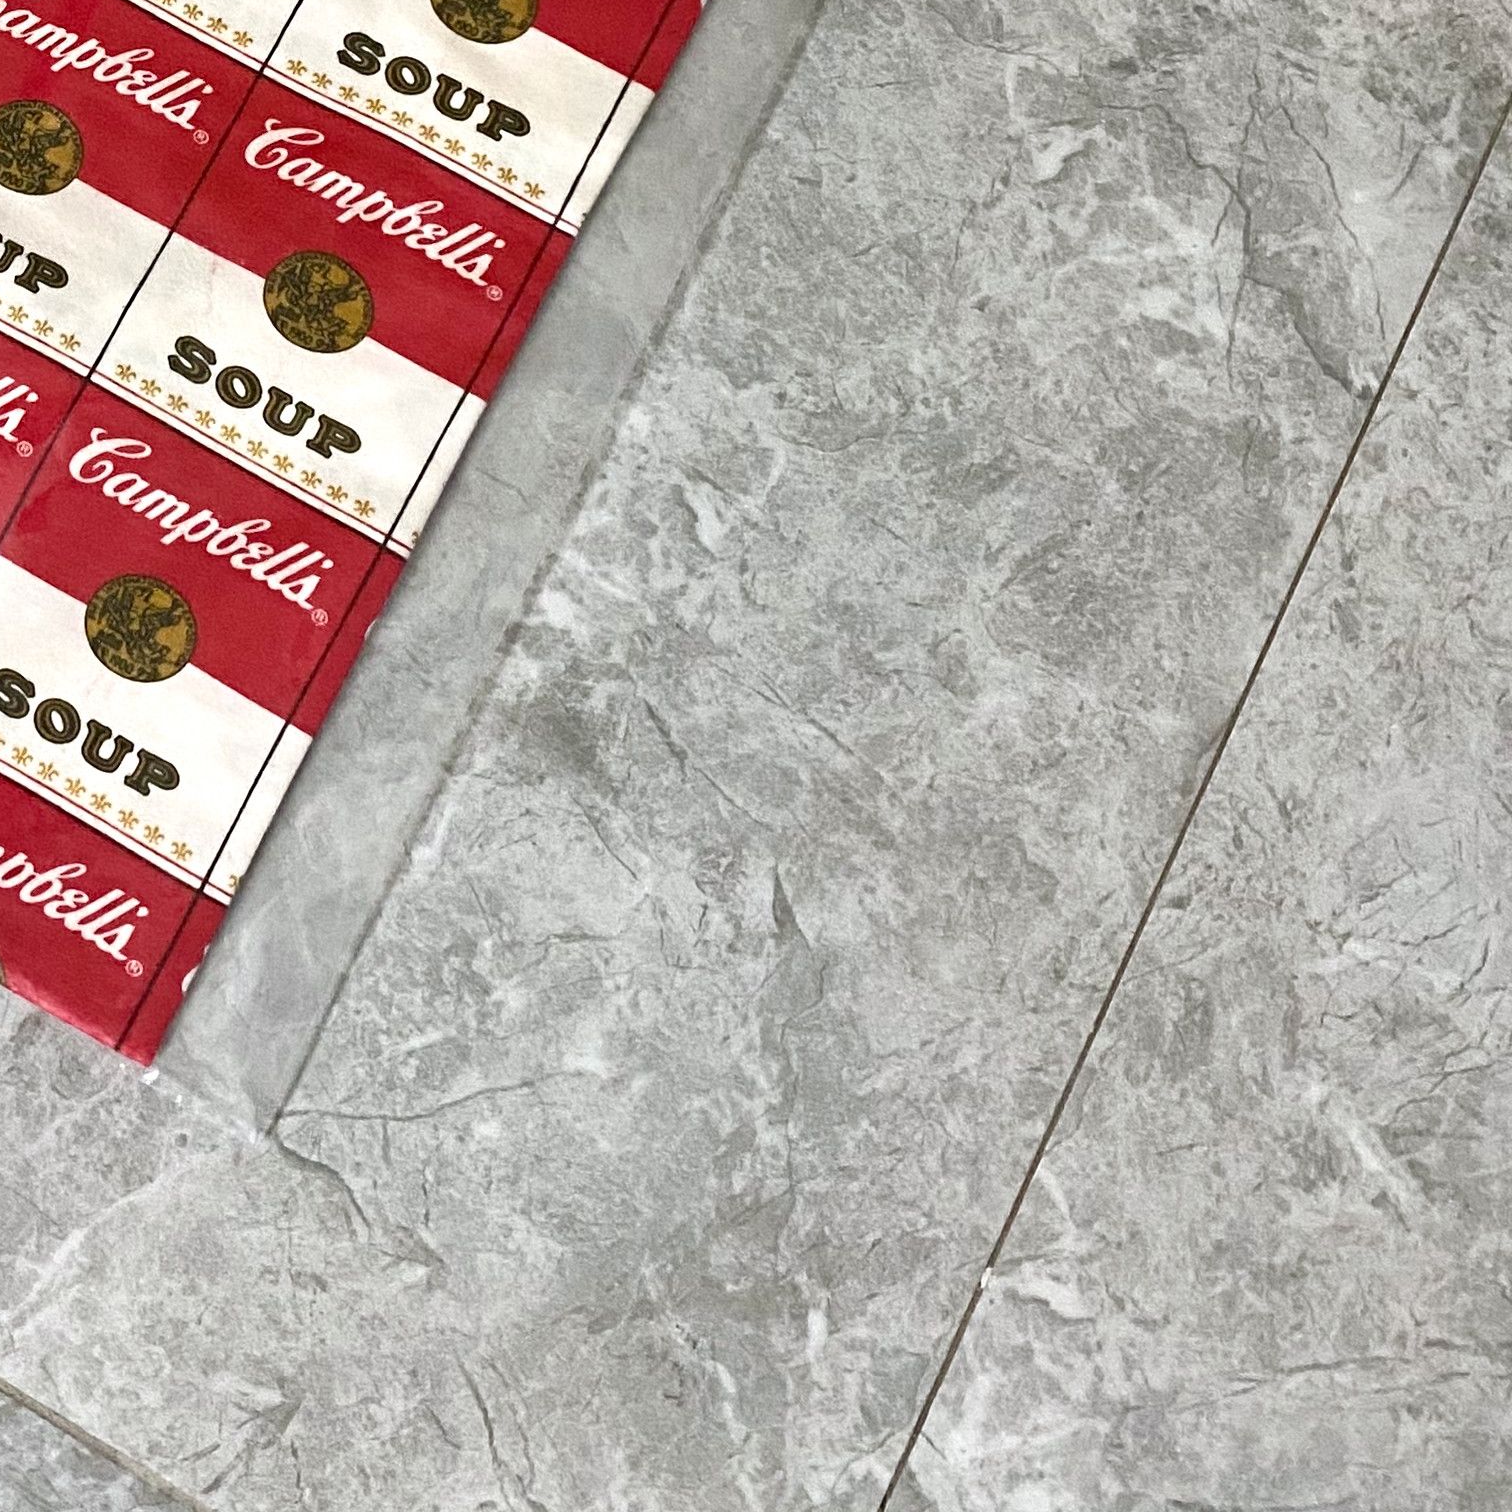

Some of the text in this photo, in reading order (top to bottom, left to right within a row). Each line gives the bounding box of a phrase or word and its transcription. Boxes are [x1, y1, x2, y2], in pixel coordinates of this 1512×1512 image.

[337, 32, 530, 141] SOUP
[245, 119, 505, 286] Campbell's
[168, 336, 361, 458] SOUP
[69, 428, 333, 609] Campbell's
